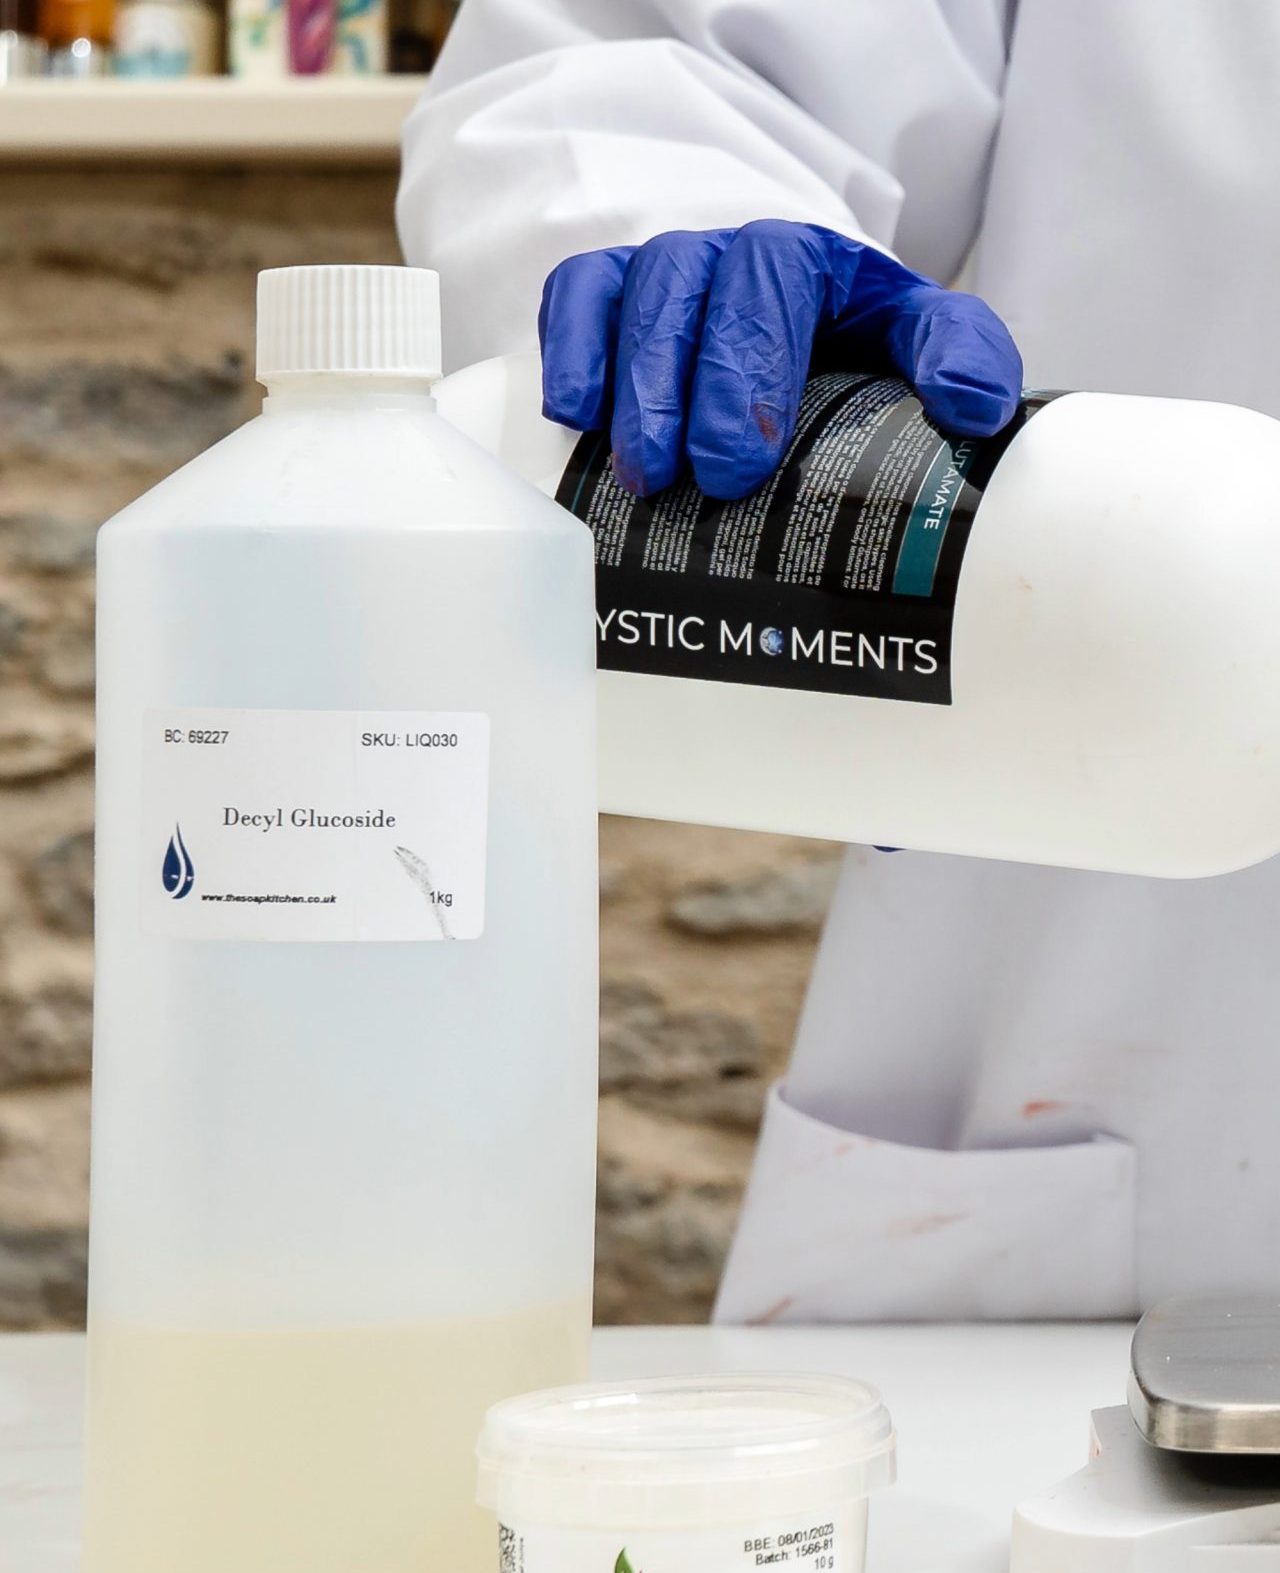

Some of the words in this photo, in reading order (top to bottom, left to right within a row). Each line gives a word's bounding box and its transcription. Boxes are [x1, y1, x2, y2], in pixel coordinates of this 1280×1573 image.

[845, 462, 857, 480] doux
[829, 480, 841, 493] par
[889, 483, 900, 499] and
[924, 440, 975, 530] LUTAMATE
[801, 488, 813, 505] pour
[797, 506, 806, 522] une
[808, 503, 817, 512] et
[815, 502, 824, 513] de
[857, 506, 868, 523] and
[875, 499, 887, 518] such
[878, 498, 895, 527] allergic
[891, 501, 902, 516] has
[739, 512, 751, 535] senza
[788, 513, 797, 525] les
[802, 511, 813, 531] doux
[808, 516, 819, 537] soins
[816, 508, 830, 533] peaux
[871, 517, 880, 528] as
[596, 526, 605, 541] Die
[648, 522, 656, 538] uso
[720, 518, 734, 547] saponi,
[727, 526, 740, 553] natura
[781, 525, 793, 552] lotions
[799, 530, 808, 541] et
[850, 522, 862, 544] body
[875, 526, 886, 543] skin
[881, 516, 897, 551] excellent
[649, 541, 659, 562] para
[658, 527, 671, 561] brillante
[663, 511, 683, 572] principalmente
[679, 530, 694, 573] excelentes
[748, 534, 761, 568] delicato
[786, 522, 802, 561] utilisation
[859, 527, 877, 572] shampoos,
[716, 547, 727, 561] gel
[729, 535, 745, 578] risciacquo
[775, 553, 786, 573] pour
[792, 540, 805, 573] brillants
[808, 536, 822, 573] sensibles
[814, 532, 831, 574] propriétés
[844, 544, 857, 574] lotions.
[868, 542, 881, 568] types.
[649, 561, 656, 571] el
[656, 561, 664, 571] al
[714, 561, 723, 576] per
[722, 553, 733, 577] acida
[738, 555, 749, 579] Sodio
[745, 568, 754, 580] ha
[782, 561, 793, 583] dans
[849, 545, 865, 590] Glutamate
[872, 551, 887, 592] cleansing
[775, 573, 783, 582] le
[790, 573, 797, 584] se
[806, 575, 813, 585] et
[813, 574, 821, 586] de
[842, 574, 851, 588] For
[859, 572, 866, 583] as
[596, 608, 705, 652] YSTIC
[165, 730, 186, 744] BC:
[188, 730, 229, 745] 69227
[361, 733, 401, 747] SKU:
[406, 733, 458, 749] LIQ030
[222, 807, 283, 832] Decyl
[291, 808, 396, 828] Glucoside
[200, 894, 337, 905] www.thesoapkitchen.co.uk
[777, 1522, 835, 1547] 08/01/2023
[796, 1538, 833, 1557] 1566-81
[815, 1556, 826, 1570] 10
